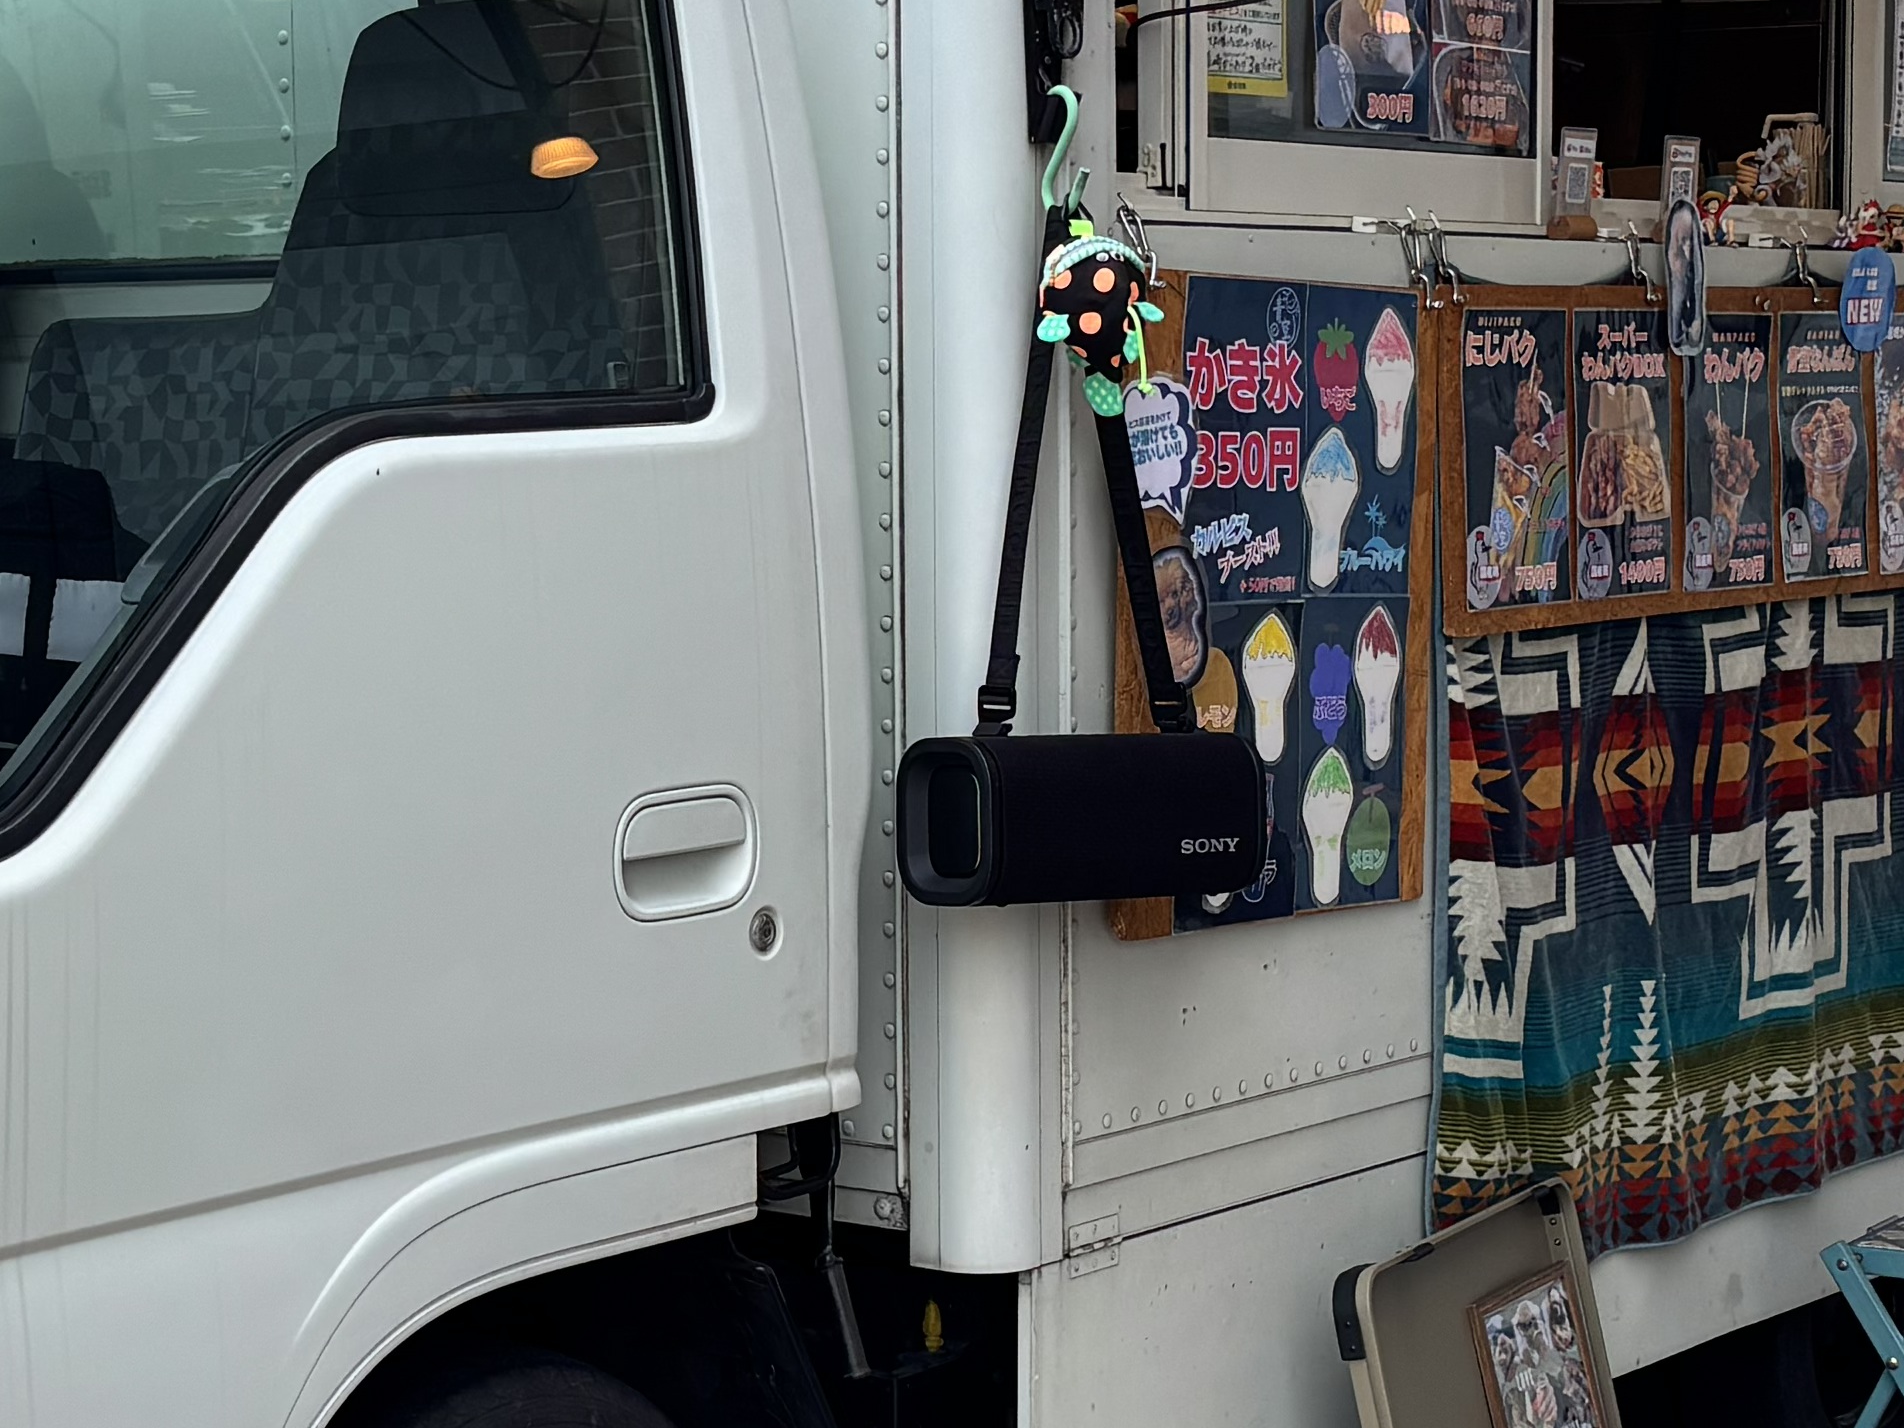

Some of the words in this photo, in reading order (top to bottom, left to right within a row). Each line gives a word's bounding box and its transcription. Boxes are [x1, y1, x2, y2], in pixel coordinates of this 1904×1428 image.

[1847, 298, 1883, 324] NEW
[1466, 330, 1536, 368] にじパク
[1597, 321, 1648, 349] スーパー
[1187, 337, 1303, 413] かき氷
[1582, 352, 1667, 381] わんパクBOX
[1704, 347, 1765, 384] わんパク
[1320, 386, 1356, 412] いちご
[1192, 427, 1300, 492] 350円
[1191, 513, 1250, 557] カルピス
[1339, 544, 1406, 573] ブルーハワイ
[1196, 705, 1236, 729] レモン
[1312, 695, 1348, 720] ぶどう
[1180, 837, 1240, 854] SONY
[1350, 848, 1386, 870] メロン
